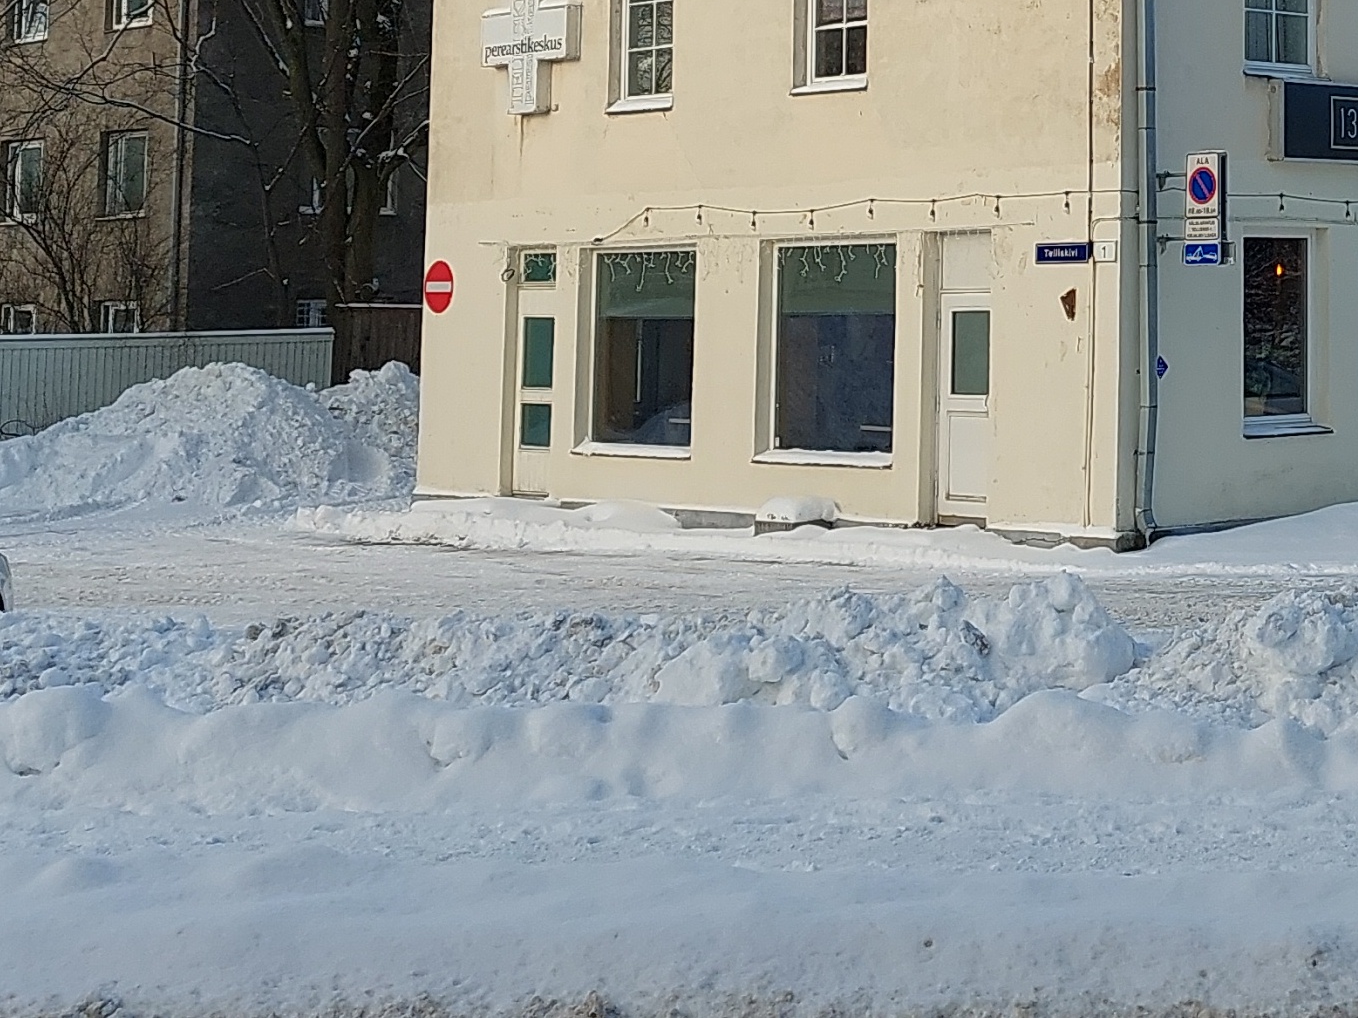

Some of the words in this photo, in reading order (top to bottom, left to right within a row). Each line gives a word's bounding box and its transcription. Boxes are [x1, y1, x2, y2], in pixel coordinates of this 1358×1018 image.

[484, 34, 563, 63] perearstikeskus
[1340, 107, 1357, 139] 13
[1196, 157, 1209, 165] ALA
[1043, 248, 1078, 258] Telliskivi
[1101, 245, 1107, 259] 1
